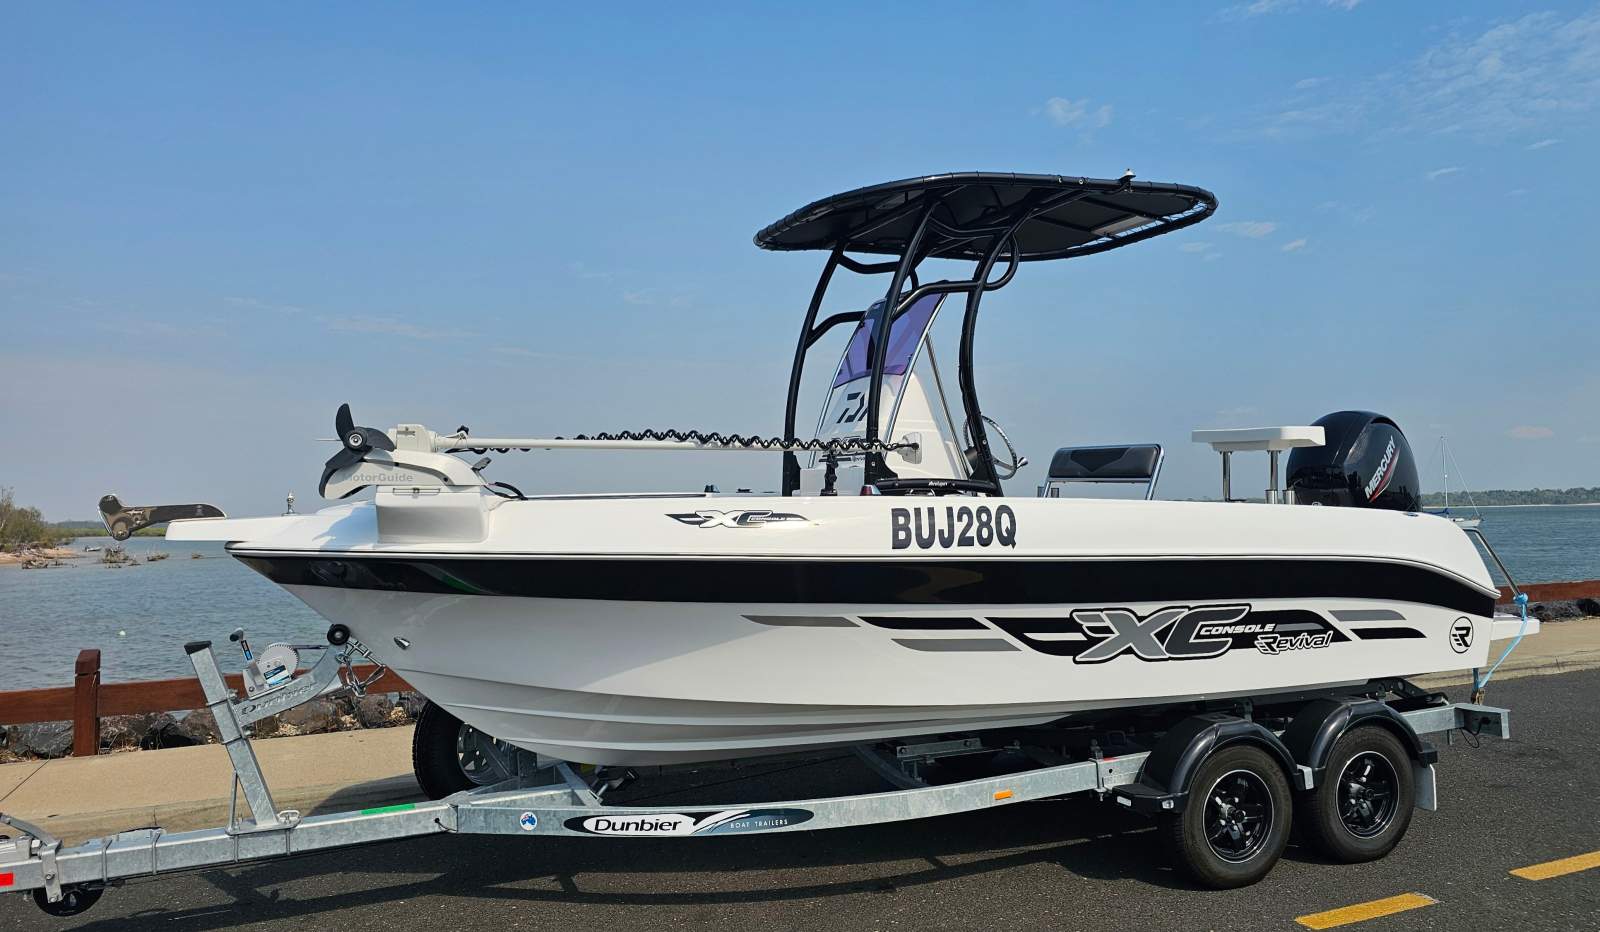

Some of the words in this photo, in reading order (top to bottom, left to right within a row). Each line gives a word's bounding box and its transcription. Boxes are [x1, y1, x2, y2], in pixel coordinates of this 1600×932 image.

[1364, 434, 1396, 500] MERCURY
[891, 504, 1017, 549] BUJ28Q
[1070, 604, 1252, 664] XC
[1200, 623, 1276, 635] CONSOLE
[1254, 631, 1333, 654] Revival
[594, 818, 682, 832] Dunbier
[730, 821, 750, 829] BOAT
[754, 818, 788, 828] TRAILERS
